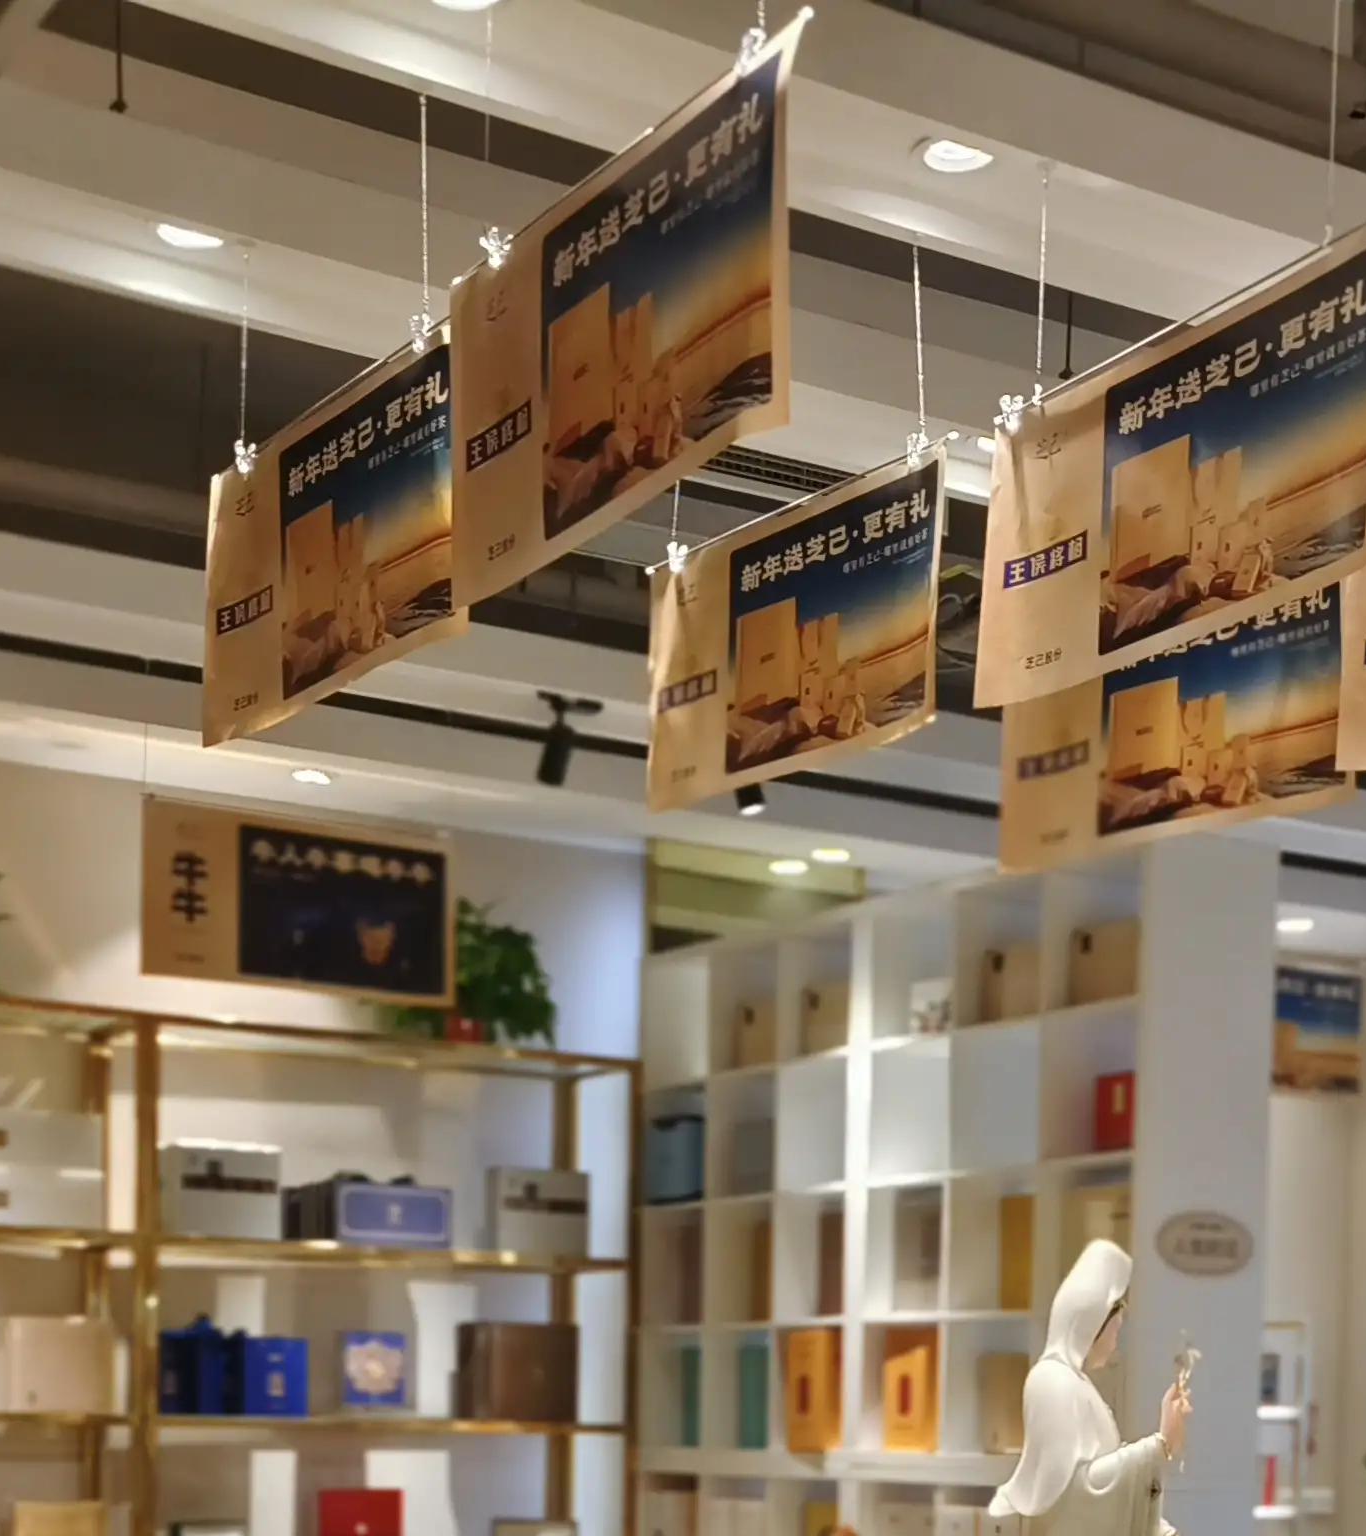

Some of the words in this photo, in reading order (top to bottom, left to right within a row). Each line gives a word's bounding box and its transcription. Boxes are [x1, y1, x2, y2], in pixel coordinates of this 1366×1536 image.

[288, 371, 449, 499] 新年送芝己·更有礼
[740, 488, 931, 594] 新年送芝己·更有礼
